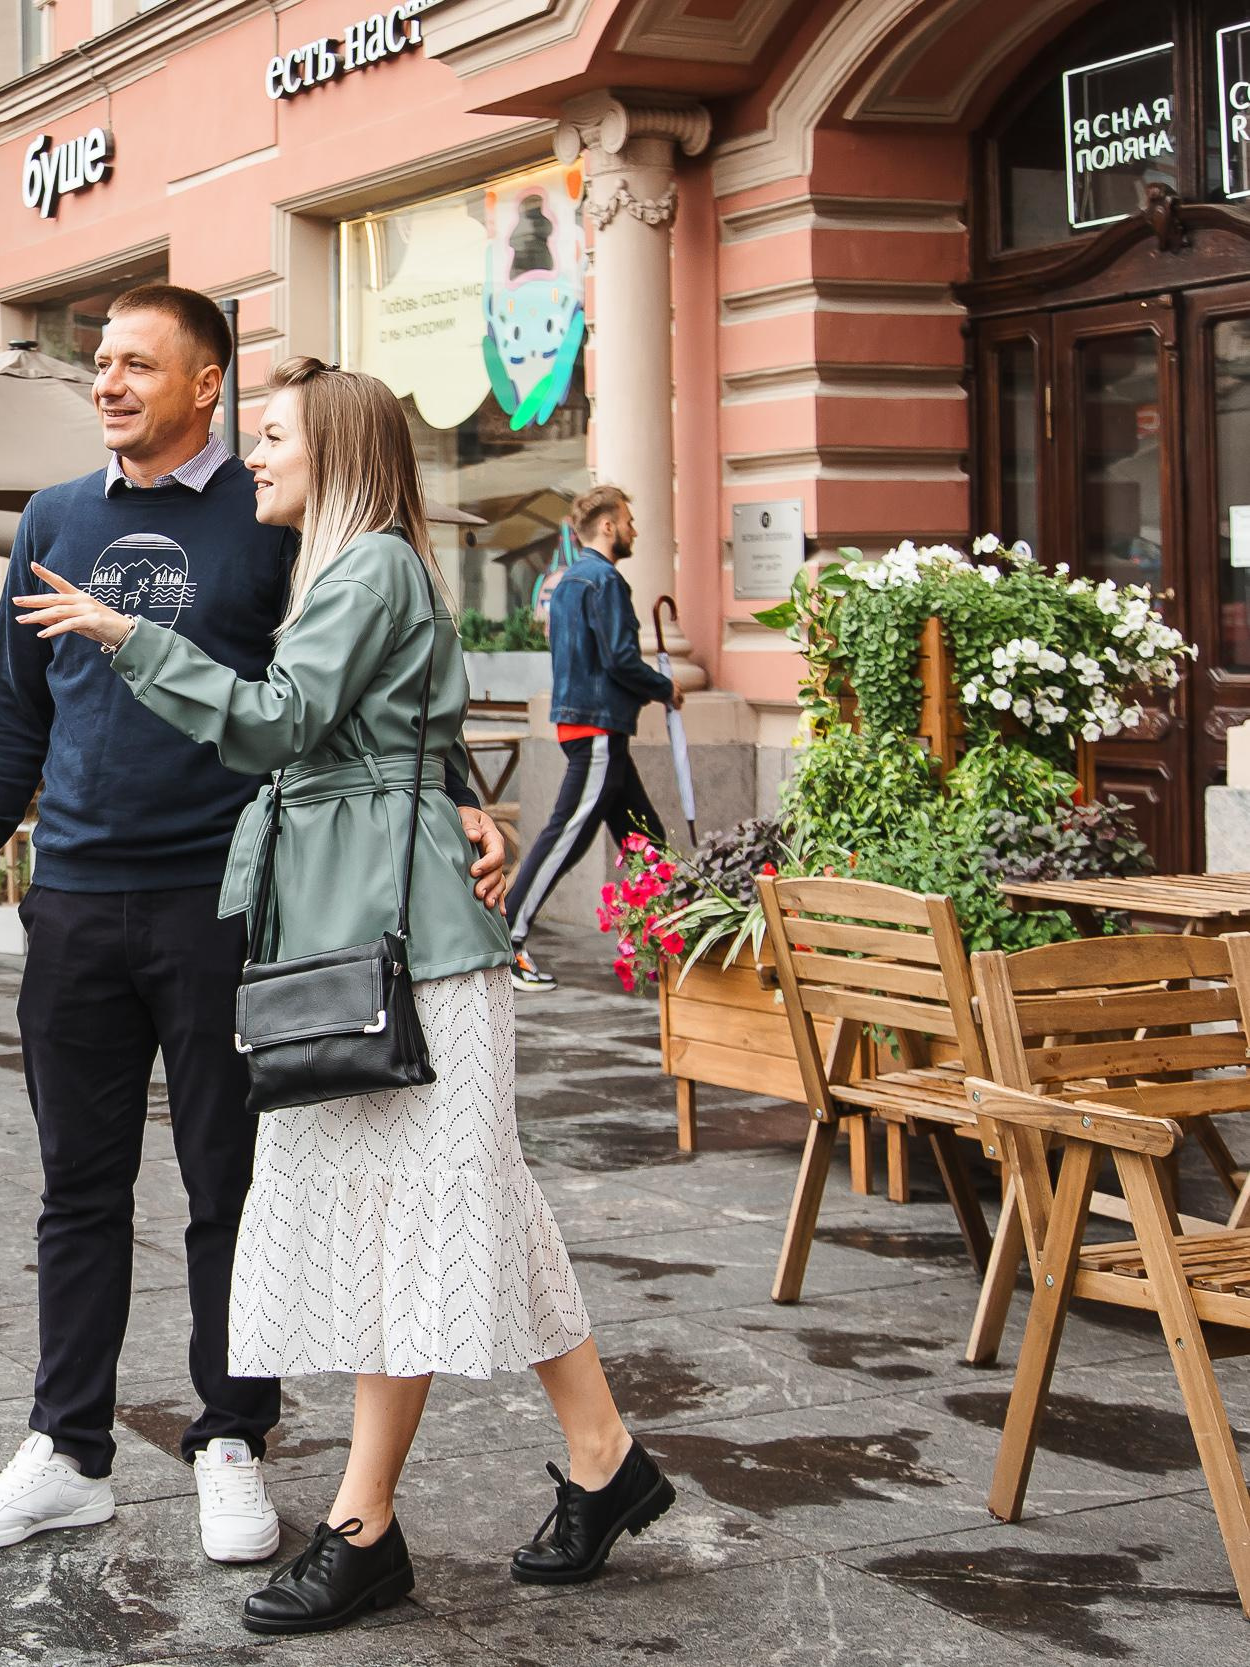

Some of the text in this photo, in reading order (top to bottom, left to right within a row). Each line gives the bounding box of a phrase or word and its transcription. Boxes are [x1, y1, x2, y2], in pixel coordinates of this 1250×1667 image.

[265, 4, 427, 100] есть наст
[1229, 81, 1250, 110] C
[1073, 97, 1172, 145] ЯСНАЯ
[22, 127, 109, 219] буше
[1075, 129, 1175, 173] ПОЛЯНА
